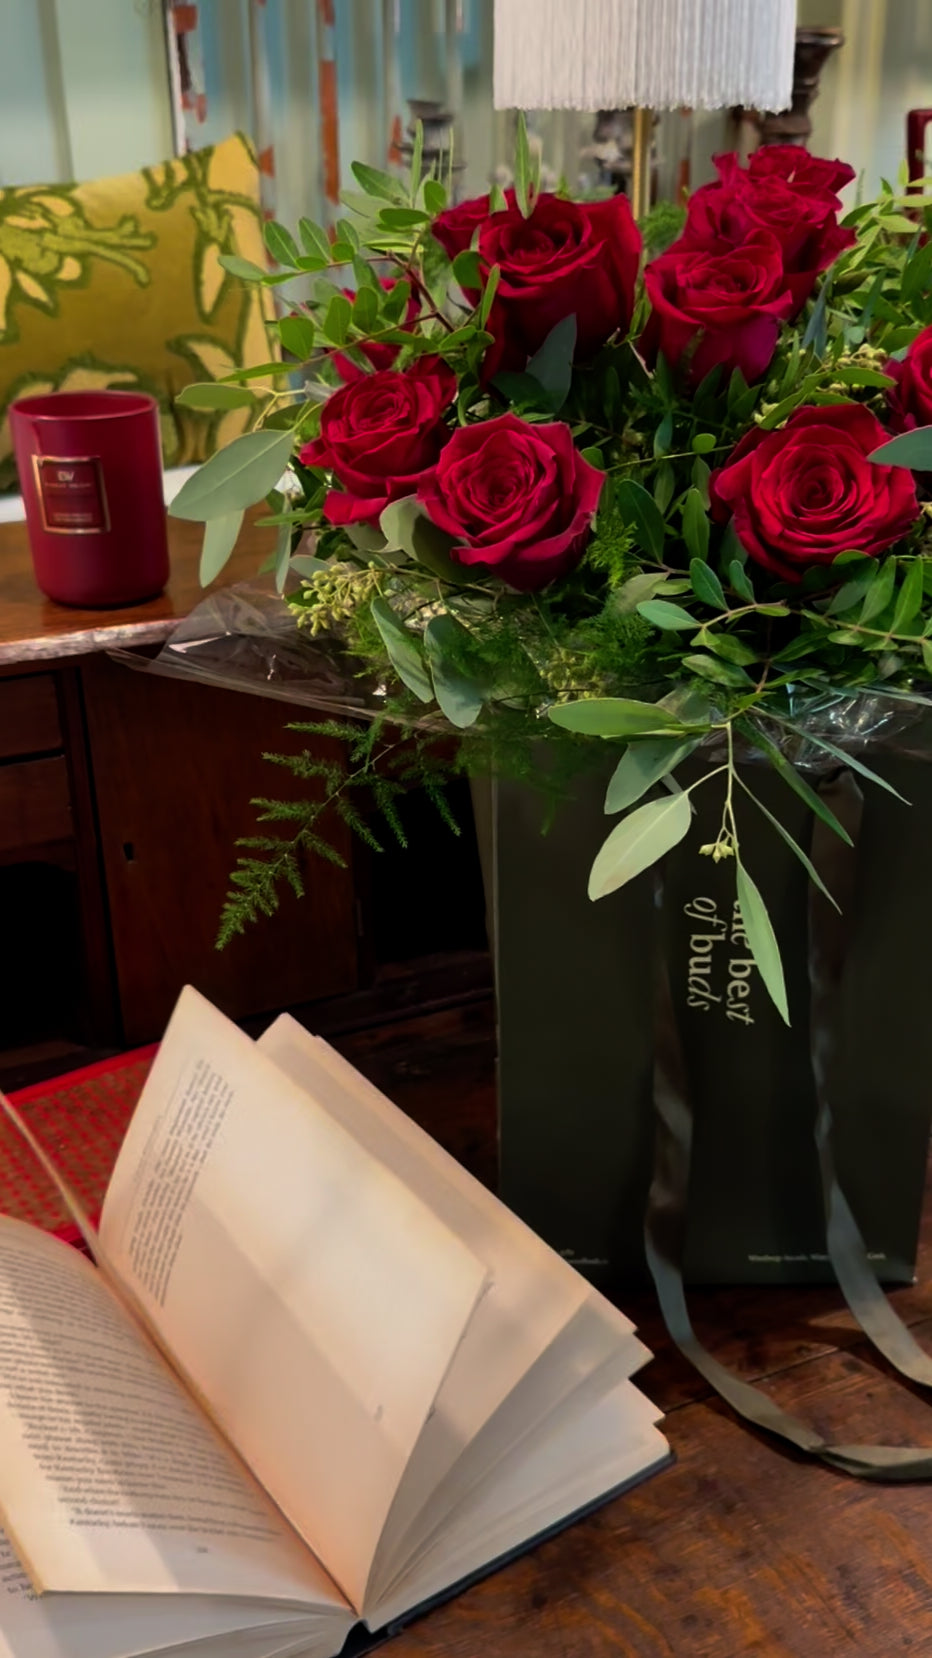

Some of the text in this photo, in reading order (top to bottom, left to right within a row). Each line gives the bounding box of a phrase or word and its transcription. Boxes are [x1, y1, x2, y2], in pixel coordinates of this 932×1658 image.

[683, 897, 728, 1011] of buds
[726, 958, 756, 1025] best
